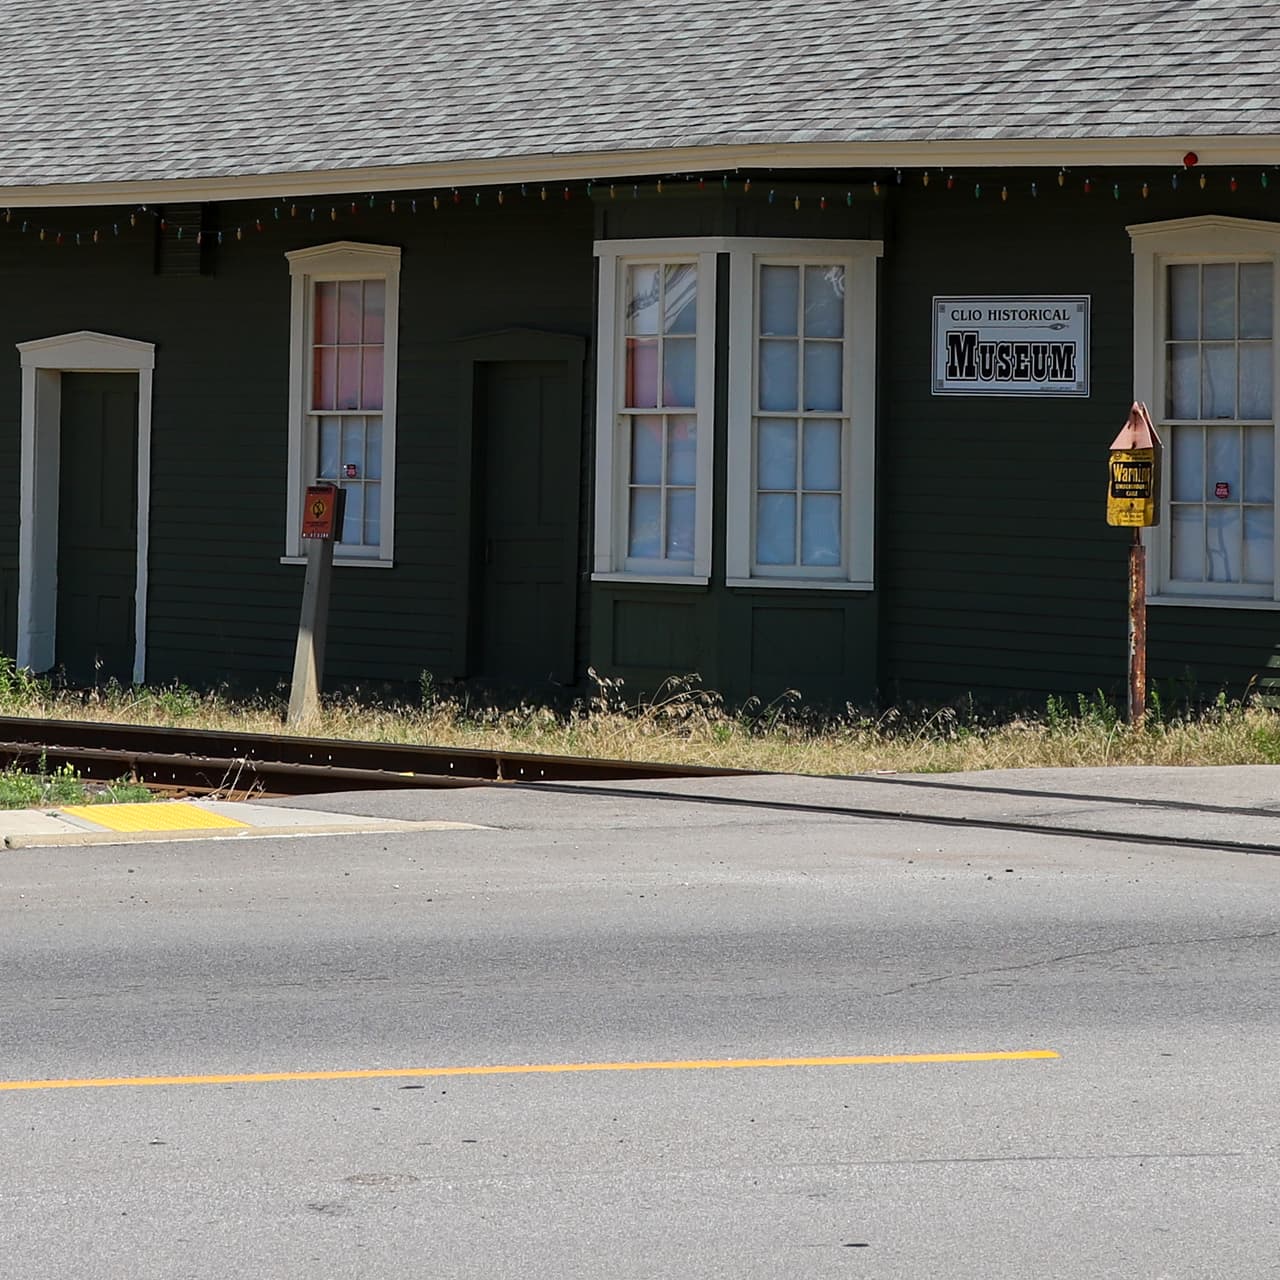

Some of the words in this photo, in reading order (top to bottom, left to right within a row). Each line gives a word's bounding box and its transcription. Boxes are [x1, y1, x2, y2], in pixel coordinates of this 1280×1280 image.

[951, 309, 982, 321] CLIO
[988, 309, 1070, 321] HISTORICAL
[946, 331, 1076, 382] MUSEUM
